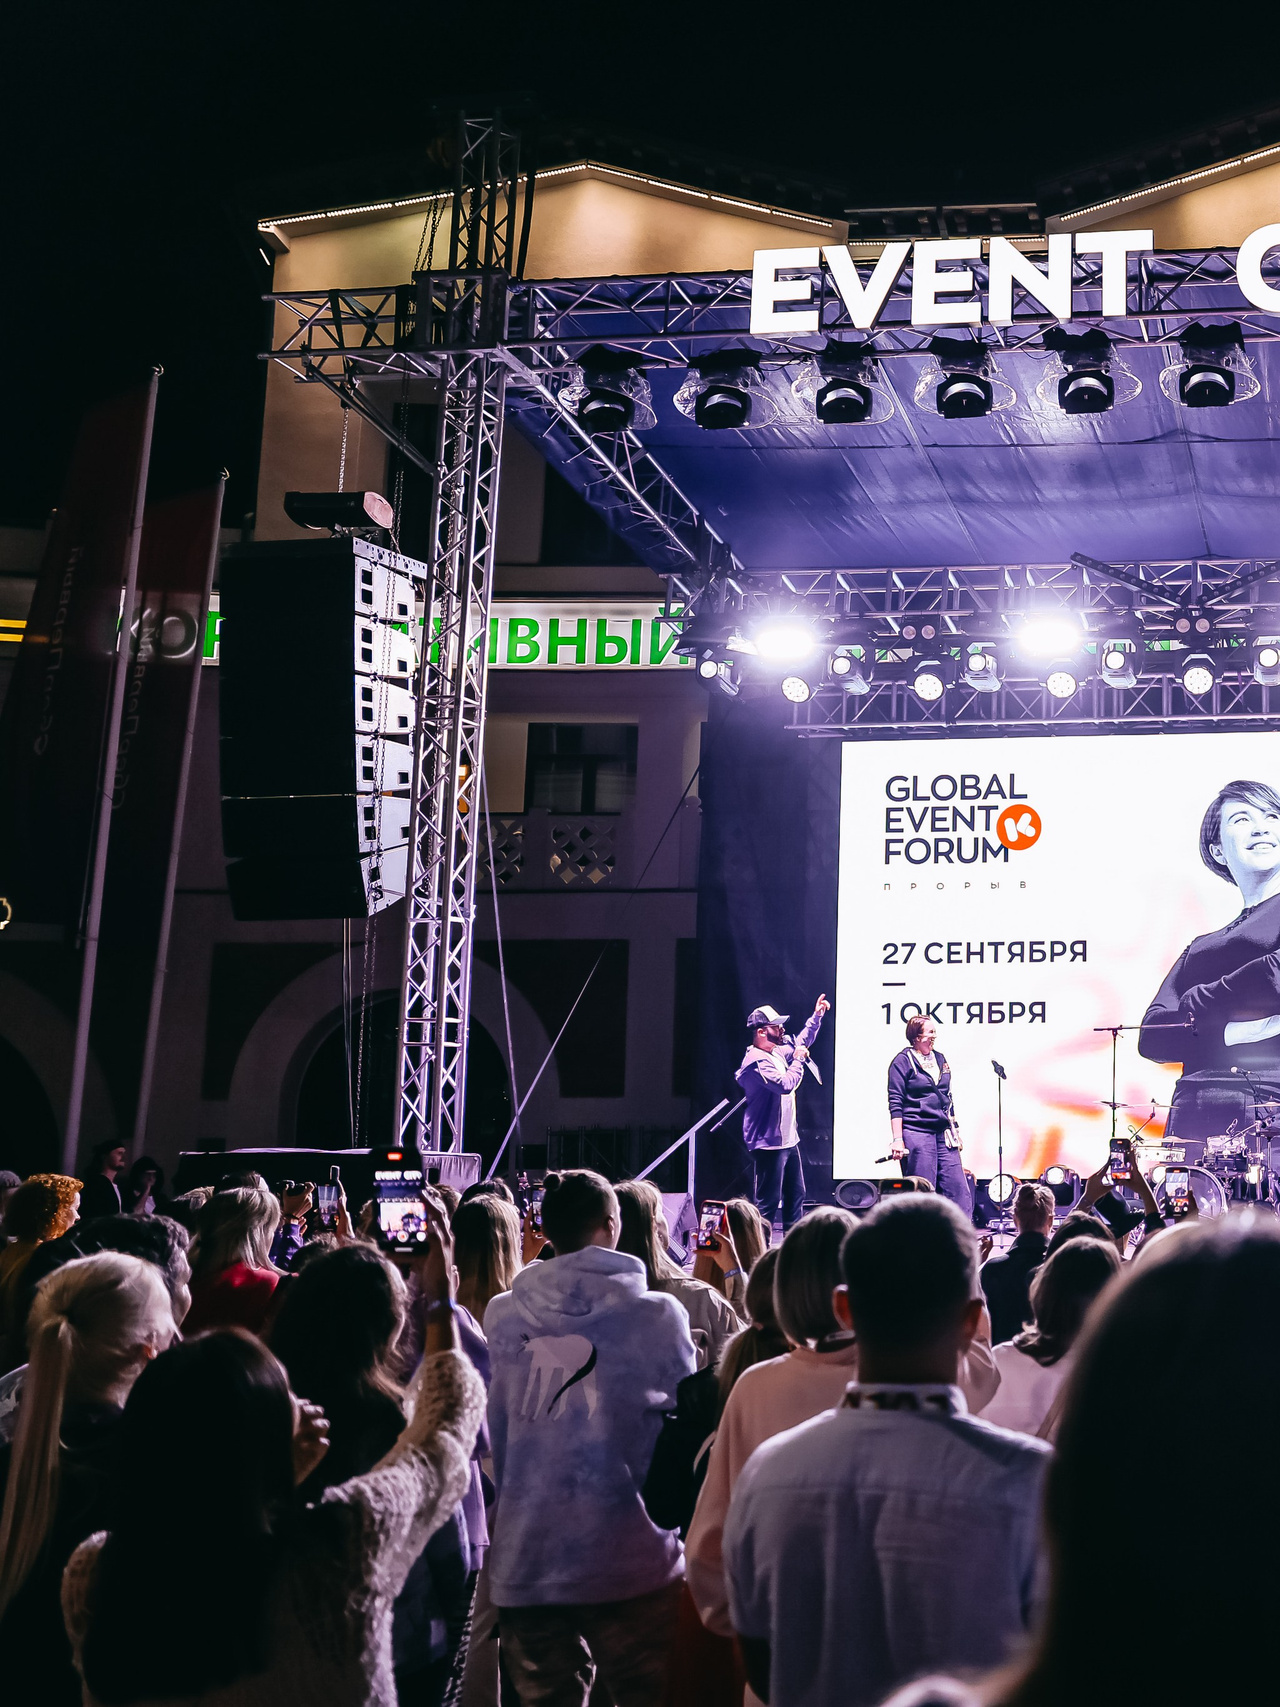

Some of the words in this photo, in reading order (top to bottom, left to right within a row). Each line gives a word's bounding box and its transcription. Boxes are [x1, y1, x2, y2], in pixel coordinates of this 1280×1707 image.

[749, 229, 1155, 335] EVENT
[885, 773, 1028, 802] GLOBAL
[885, 805, 999, 833] EVENT
[884, 837, 1009, 865] FORUM
[882, 942, 916, 965] 27
[924, 940, 1087, 964] СЕНТЯБРЯ
[881, 1002, 891, 1025] 1
